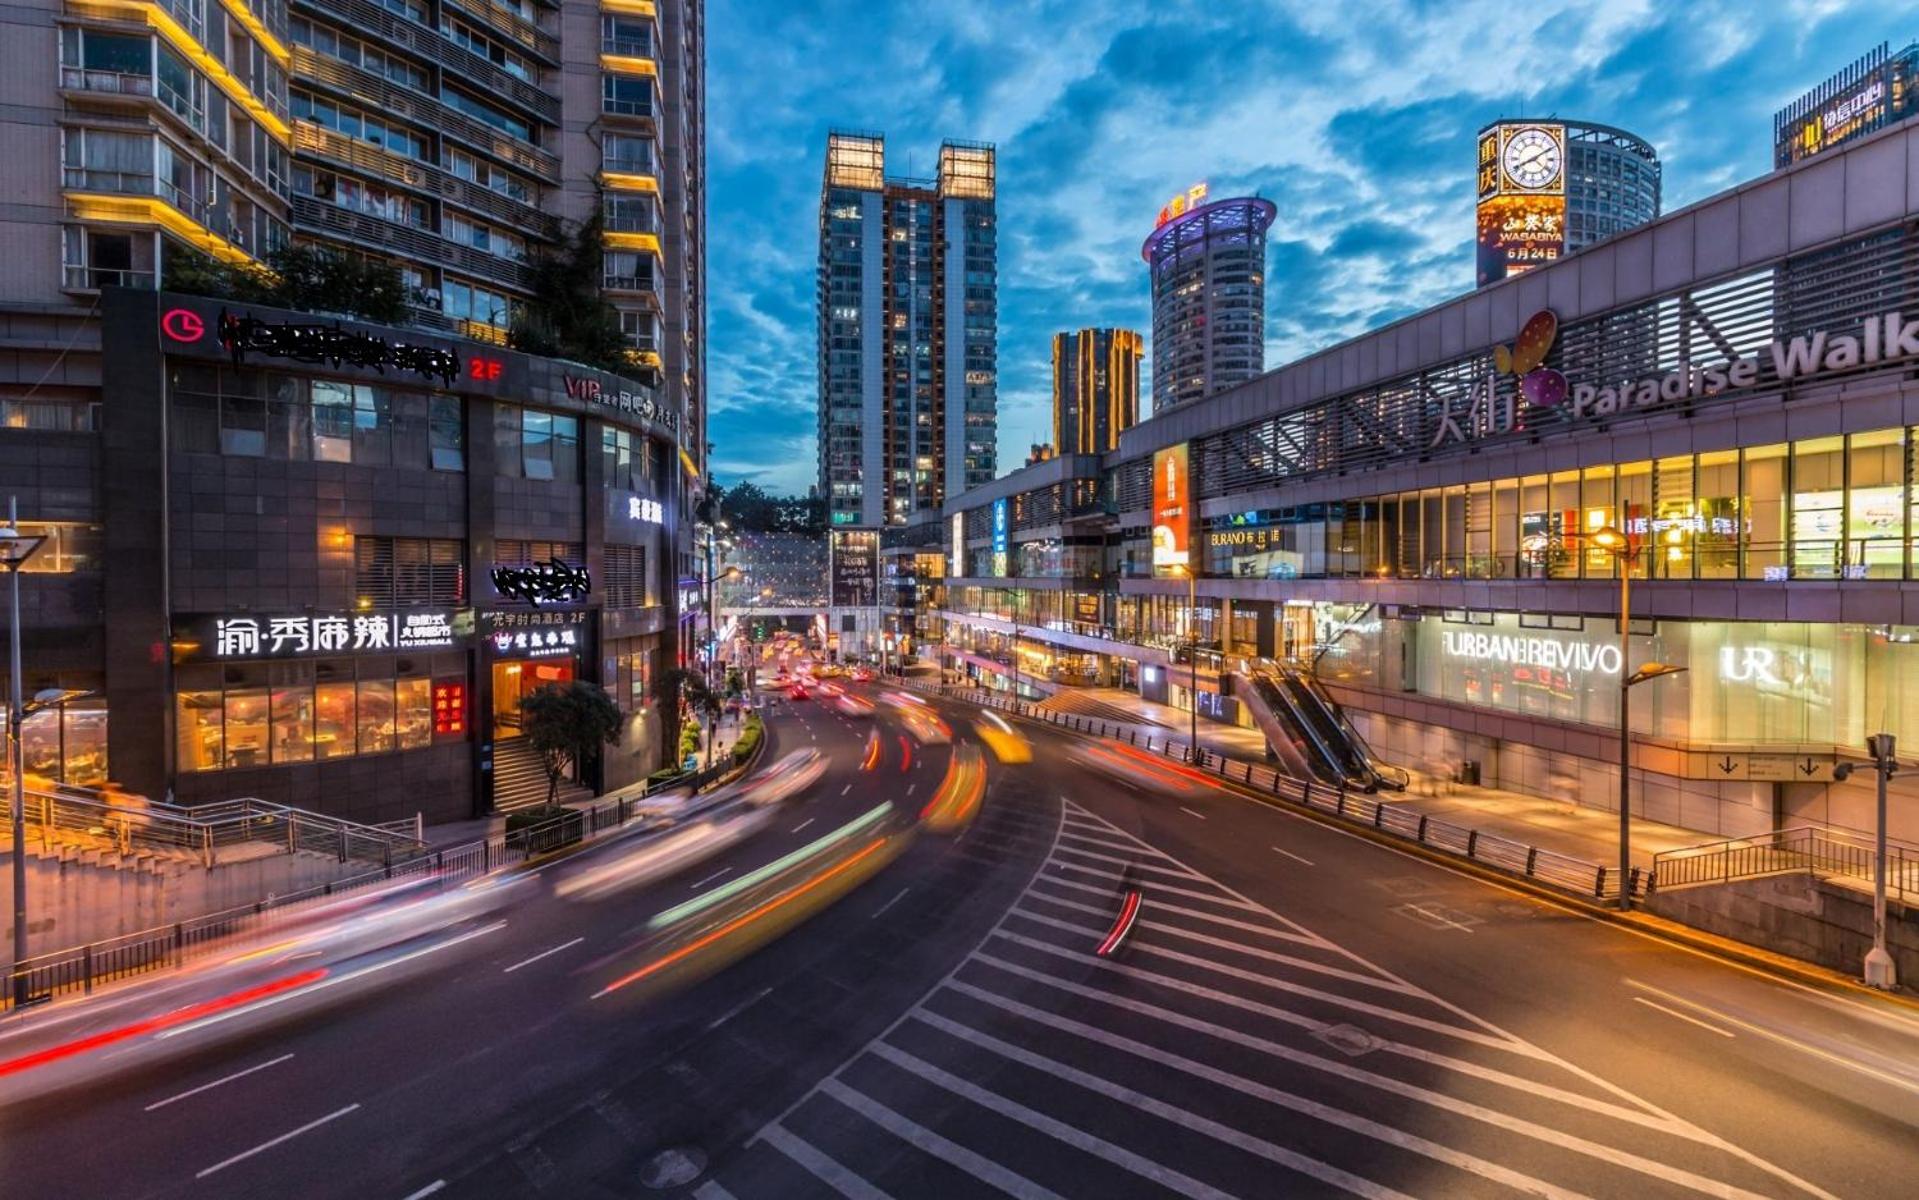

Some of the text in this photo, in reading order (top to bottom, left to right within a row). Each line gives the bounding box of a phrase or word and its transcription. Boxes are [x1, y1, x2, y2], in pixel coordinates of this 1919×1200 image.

[1481, 137, 1497, 193] 重庆
[1500, 232, 1563, 242] WASABIYA
[1508, 248, 1557, 260] 6月24日
[471, 357, 502, 380] 2F
[1573, 356, 1758, 418] Paradise
[1770, 311, 1919, 379] Walk
[565, 376, 600, 399] VIP
[1211, 531, 1246, 545] BURANO
[571, 611, 586, 623] 2F
[1450, 631, 1622, 674] URBAN REVIVO
[1720, 646, 1776, 684] UR
